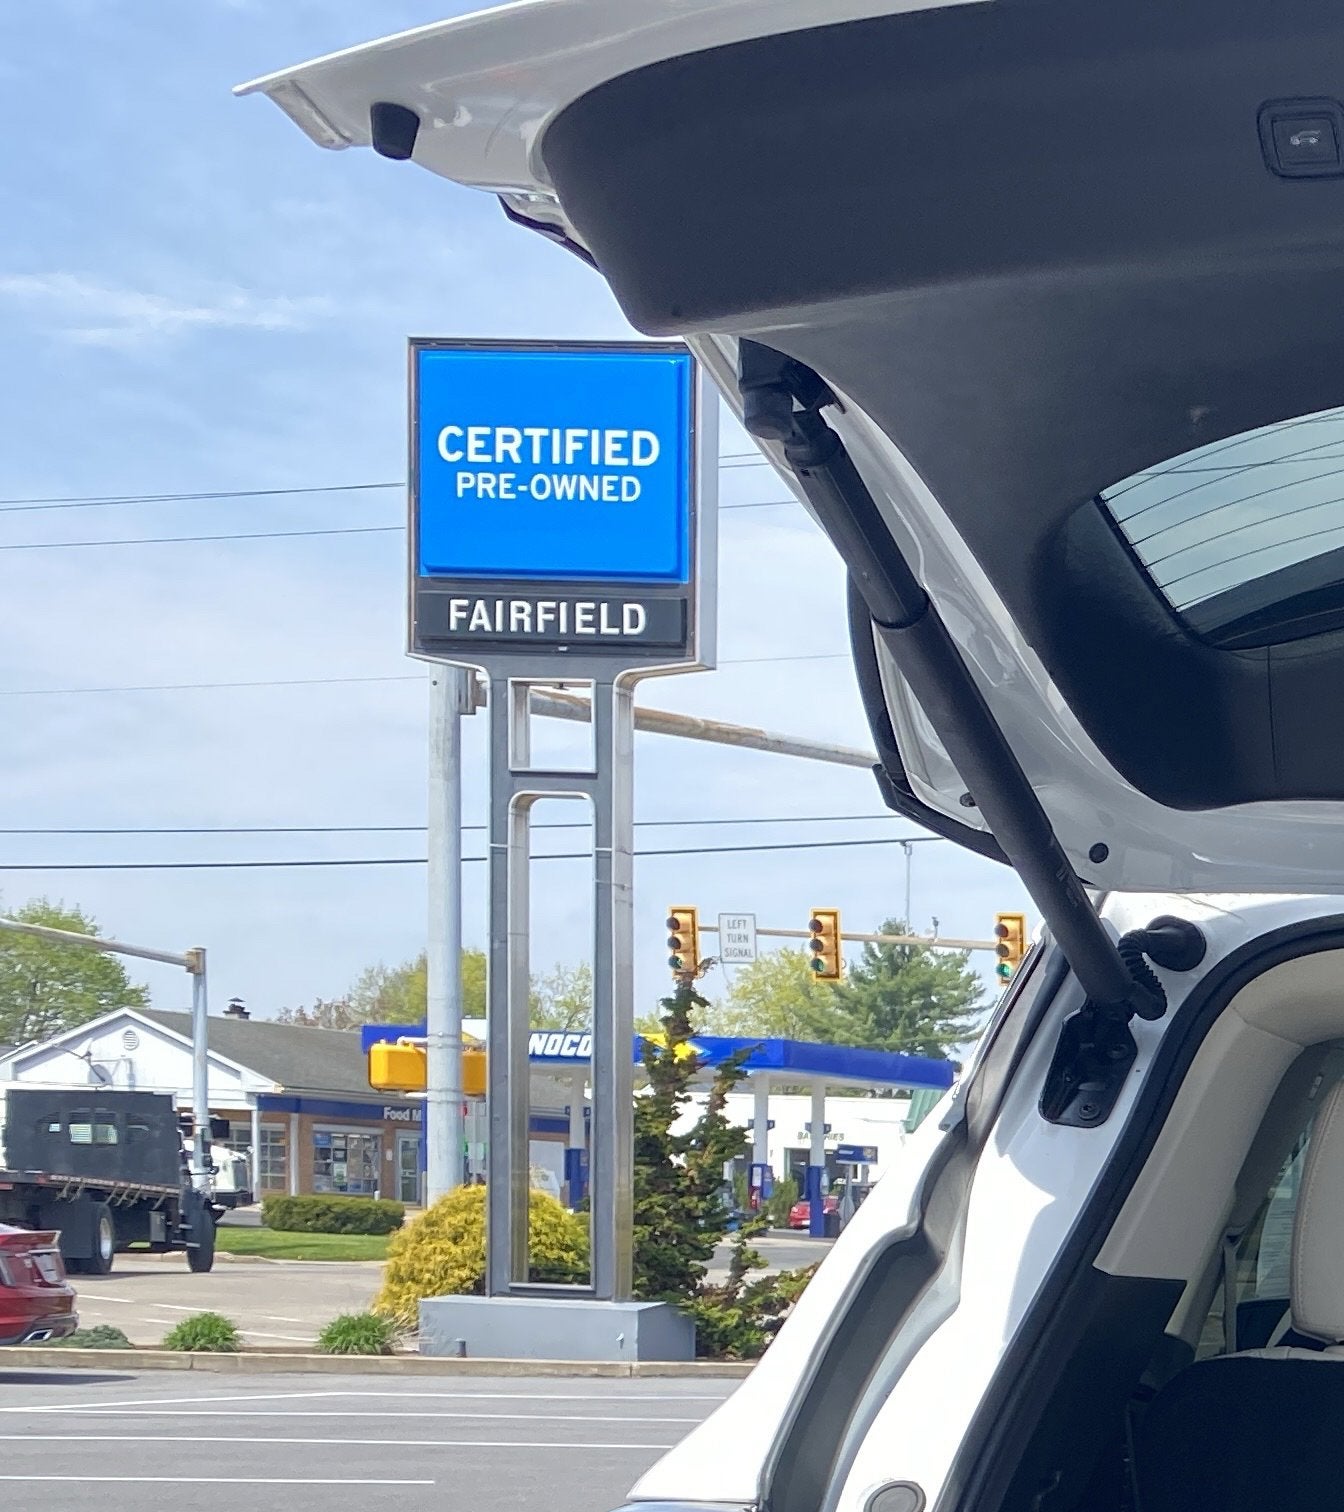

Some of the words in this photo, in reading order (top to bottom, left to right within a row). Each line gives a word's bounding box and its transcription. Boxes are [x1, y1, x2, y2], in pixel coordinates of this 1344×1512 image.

[437, 425, 661, 467] CERTIFIED
[456, 472, 642, 502] PRE-OWNED
[448, 598, 647, 636] FAIRFIELD
[726, 919, 747, 930] LEFT
[726, 933, 749, 944] TURN
[724, 947, 754, 958] SIGNAL
[528, 1033, 592, 1057] NOCO
[383, 1106, 410, 1121] Food
[797, 1131, 845, 1142] BARIES
